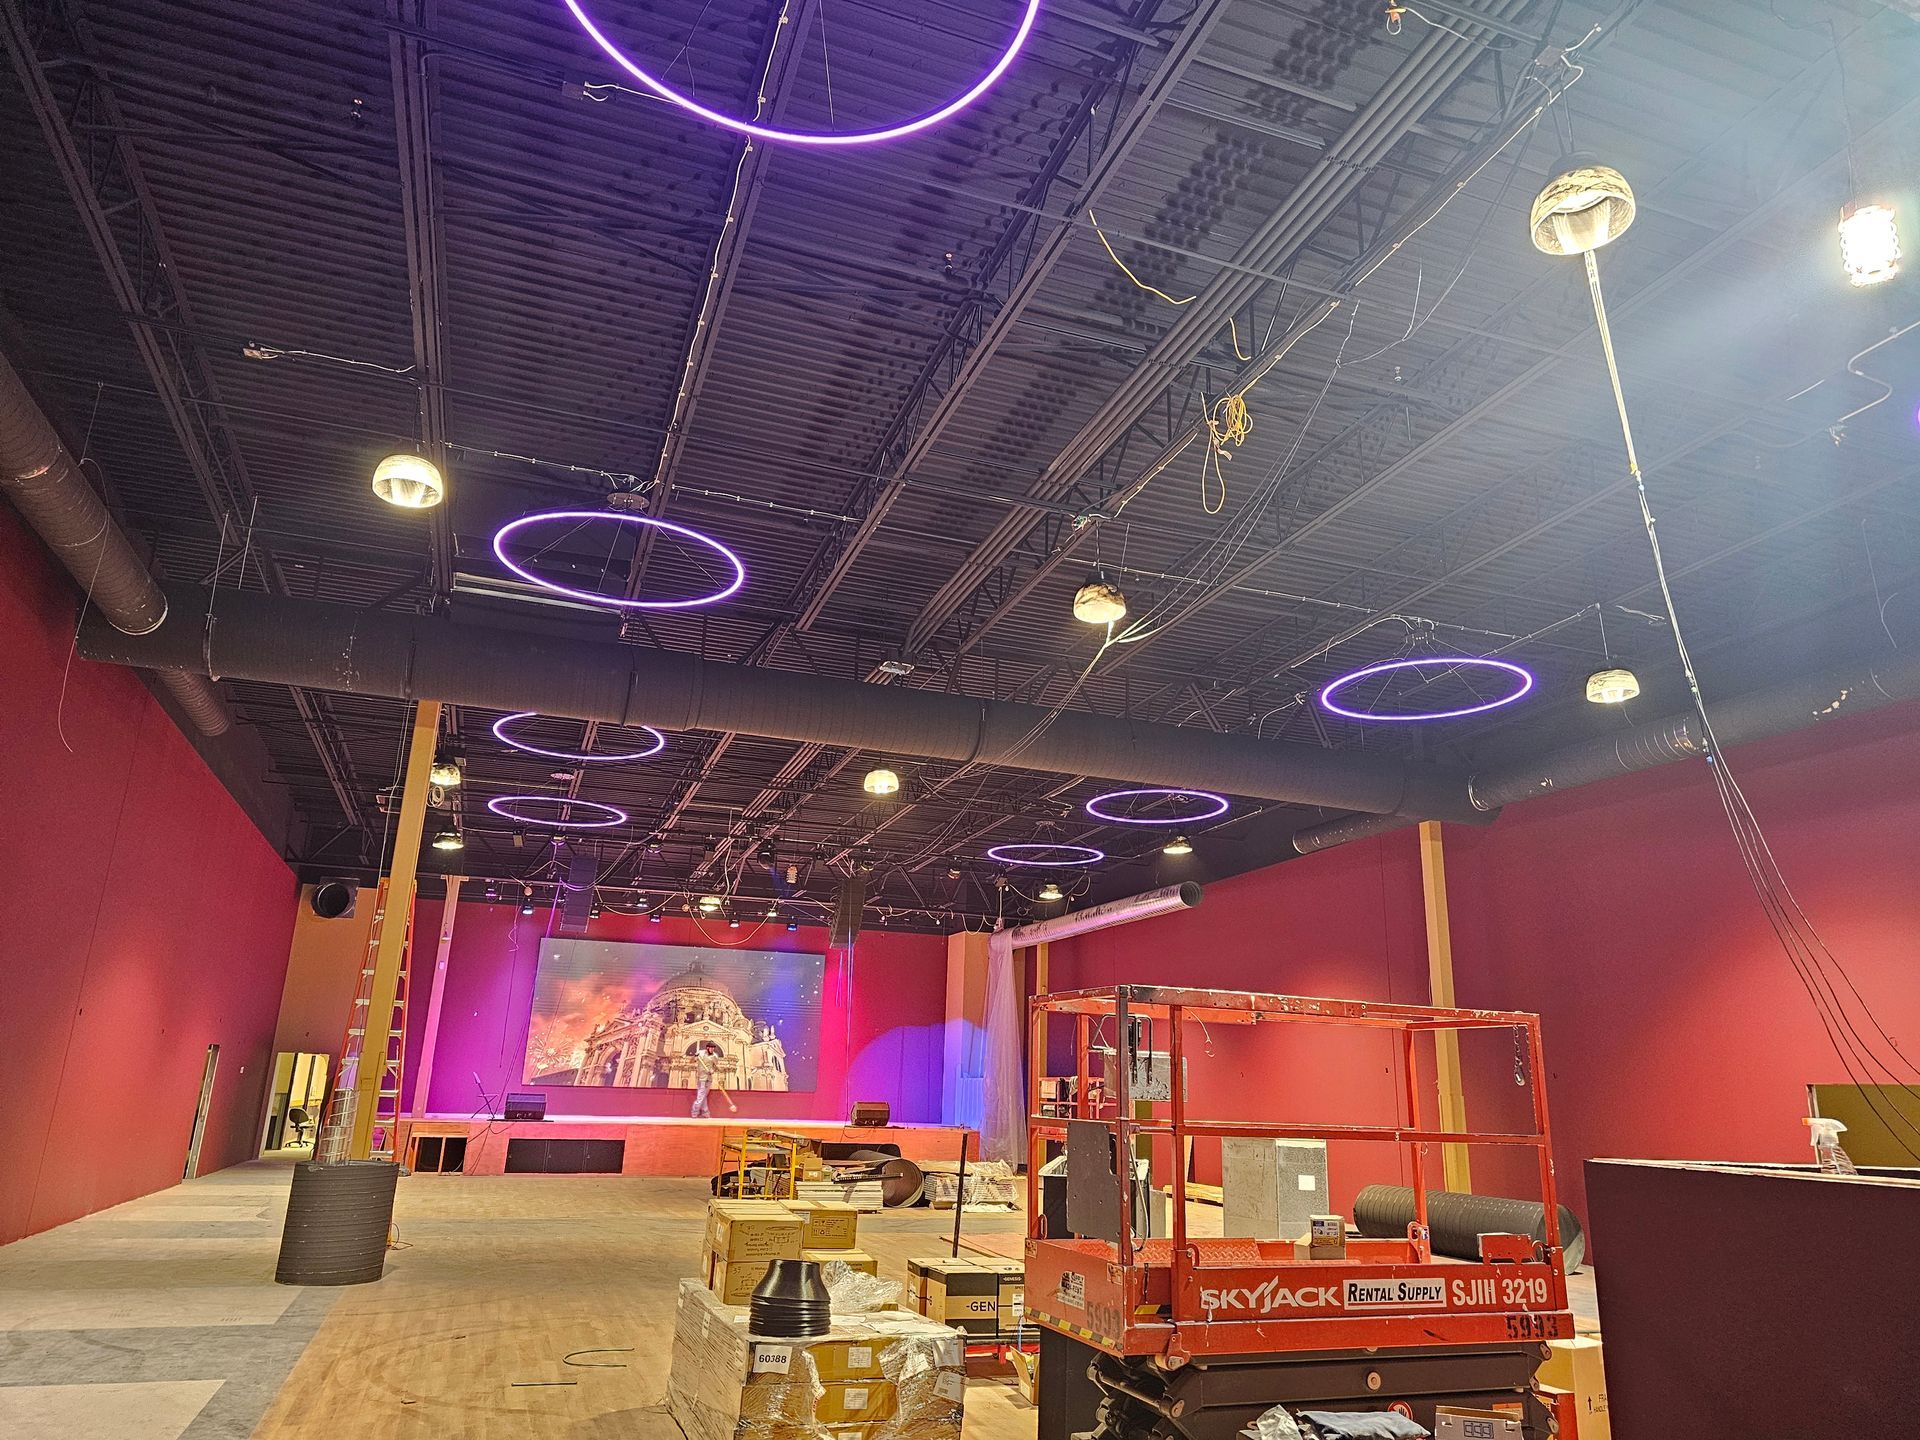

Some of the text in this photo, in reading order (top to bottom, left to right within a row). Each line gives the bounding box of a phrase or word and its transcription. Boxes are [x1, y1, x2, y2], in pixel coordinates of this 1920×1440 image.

[1200, 1275, 1342, 1314] SKYJACK
[1347, 1282, 1442, 1301] RENTAL SUPPLY
[1502, 1278, 1547, 1304] 3219
[1506, 1314, 1559, 1338] 5993
